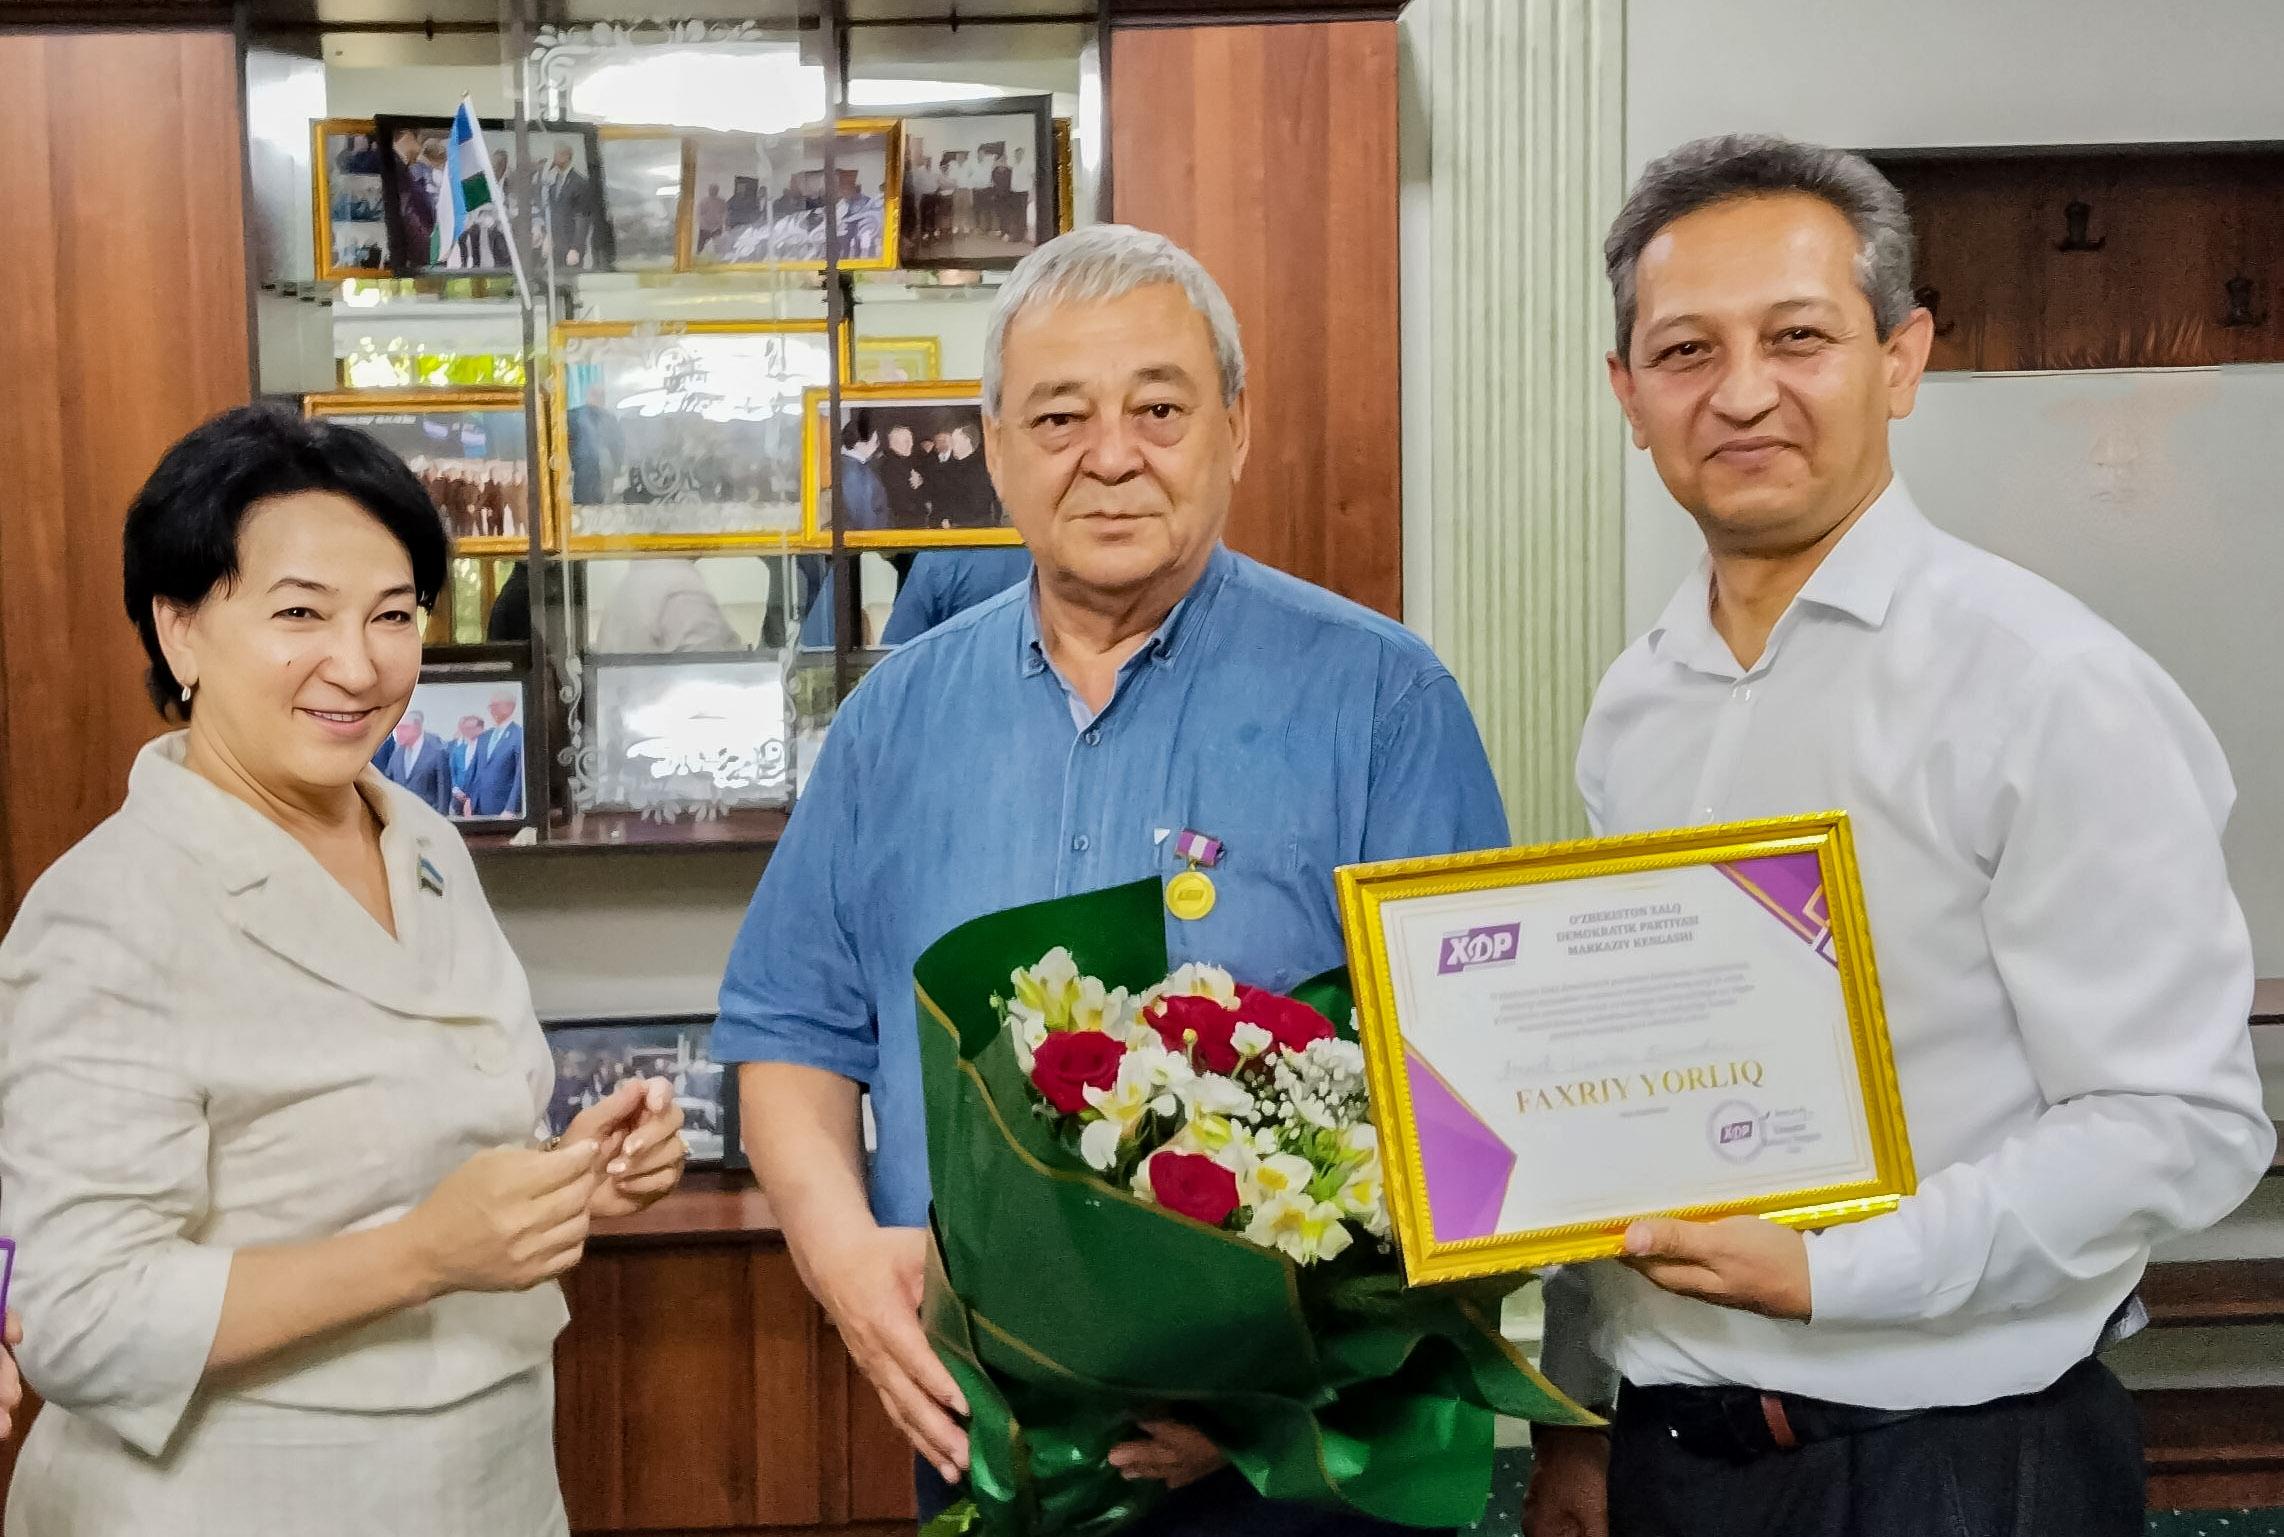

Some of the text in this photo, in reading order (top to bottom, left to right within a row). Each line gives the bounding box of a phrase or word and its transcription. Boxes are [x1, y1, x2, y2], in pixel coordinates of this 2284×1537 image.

[1556, 915, 1700, 942] DEMOKRATIK PARTIYASI
[1568, 931, 1693, 956] MARKAZIY KENGASHI
[1515, 1060, 1764, 1114] FAXRIY YORLIQ
